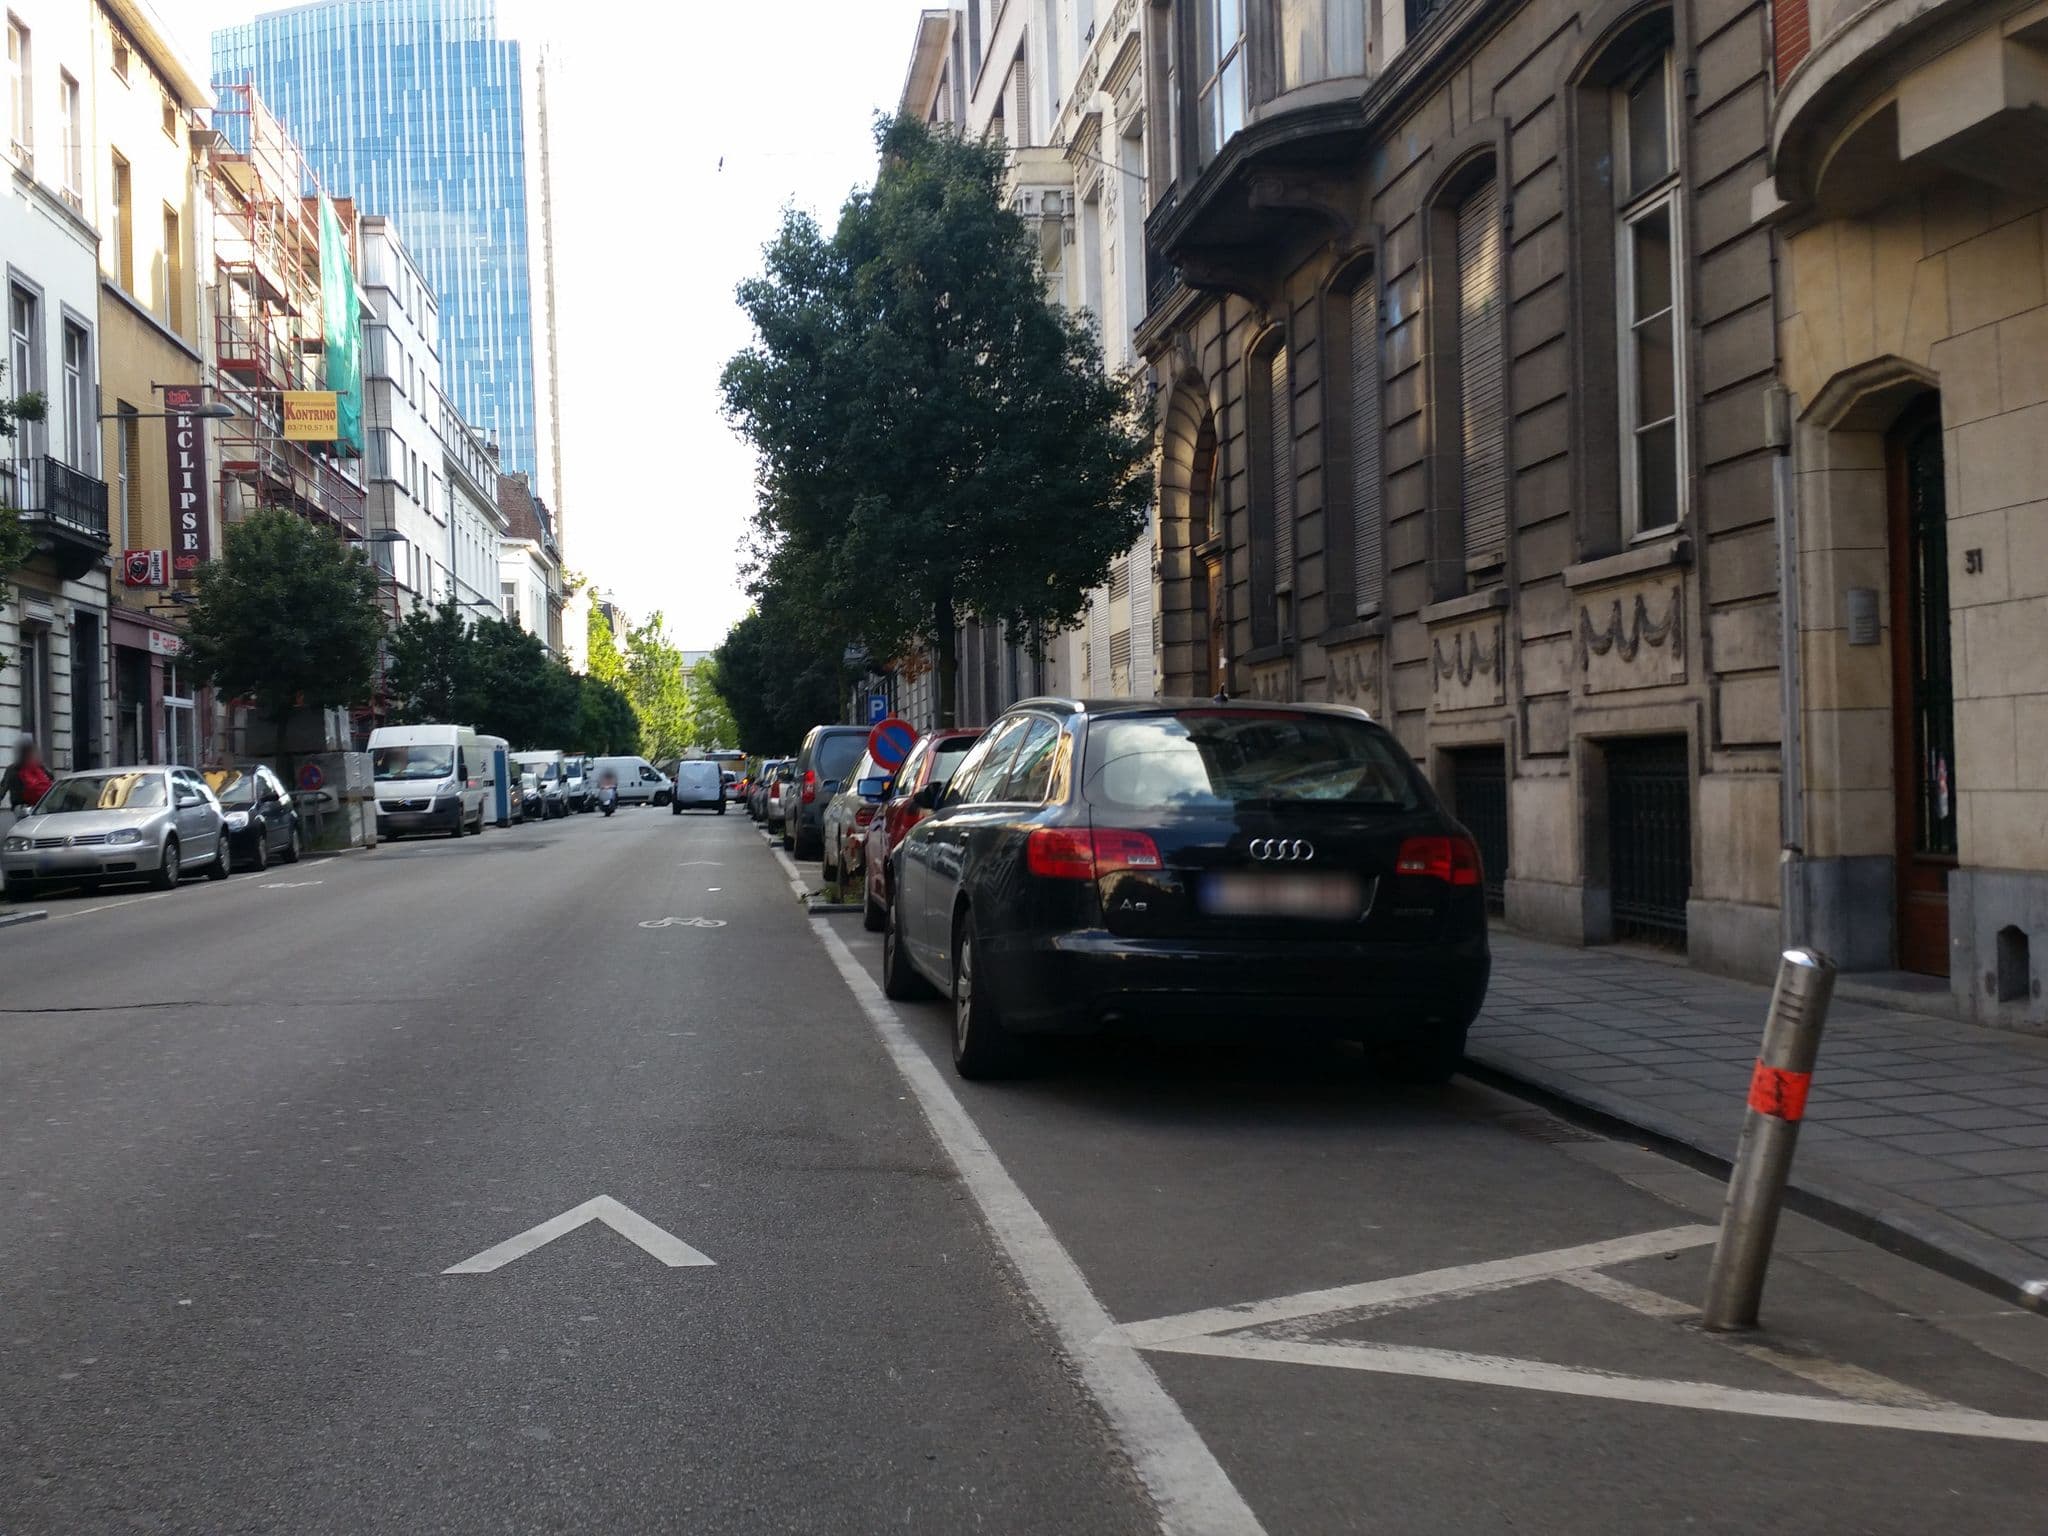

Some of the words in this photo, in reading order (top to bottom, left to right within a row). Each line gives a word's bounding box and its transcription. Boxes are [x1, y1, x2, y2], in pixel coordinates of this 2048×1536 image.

[177, 411, 198, 550] ECLIPSE
[151, 552, 160, 583] Jupiler
[1965, 547, 1983, 574] 31
[871, 700, 884, 719] P
